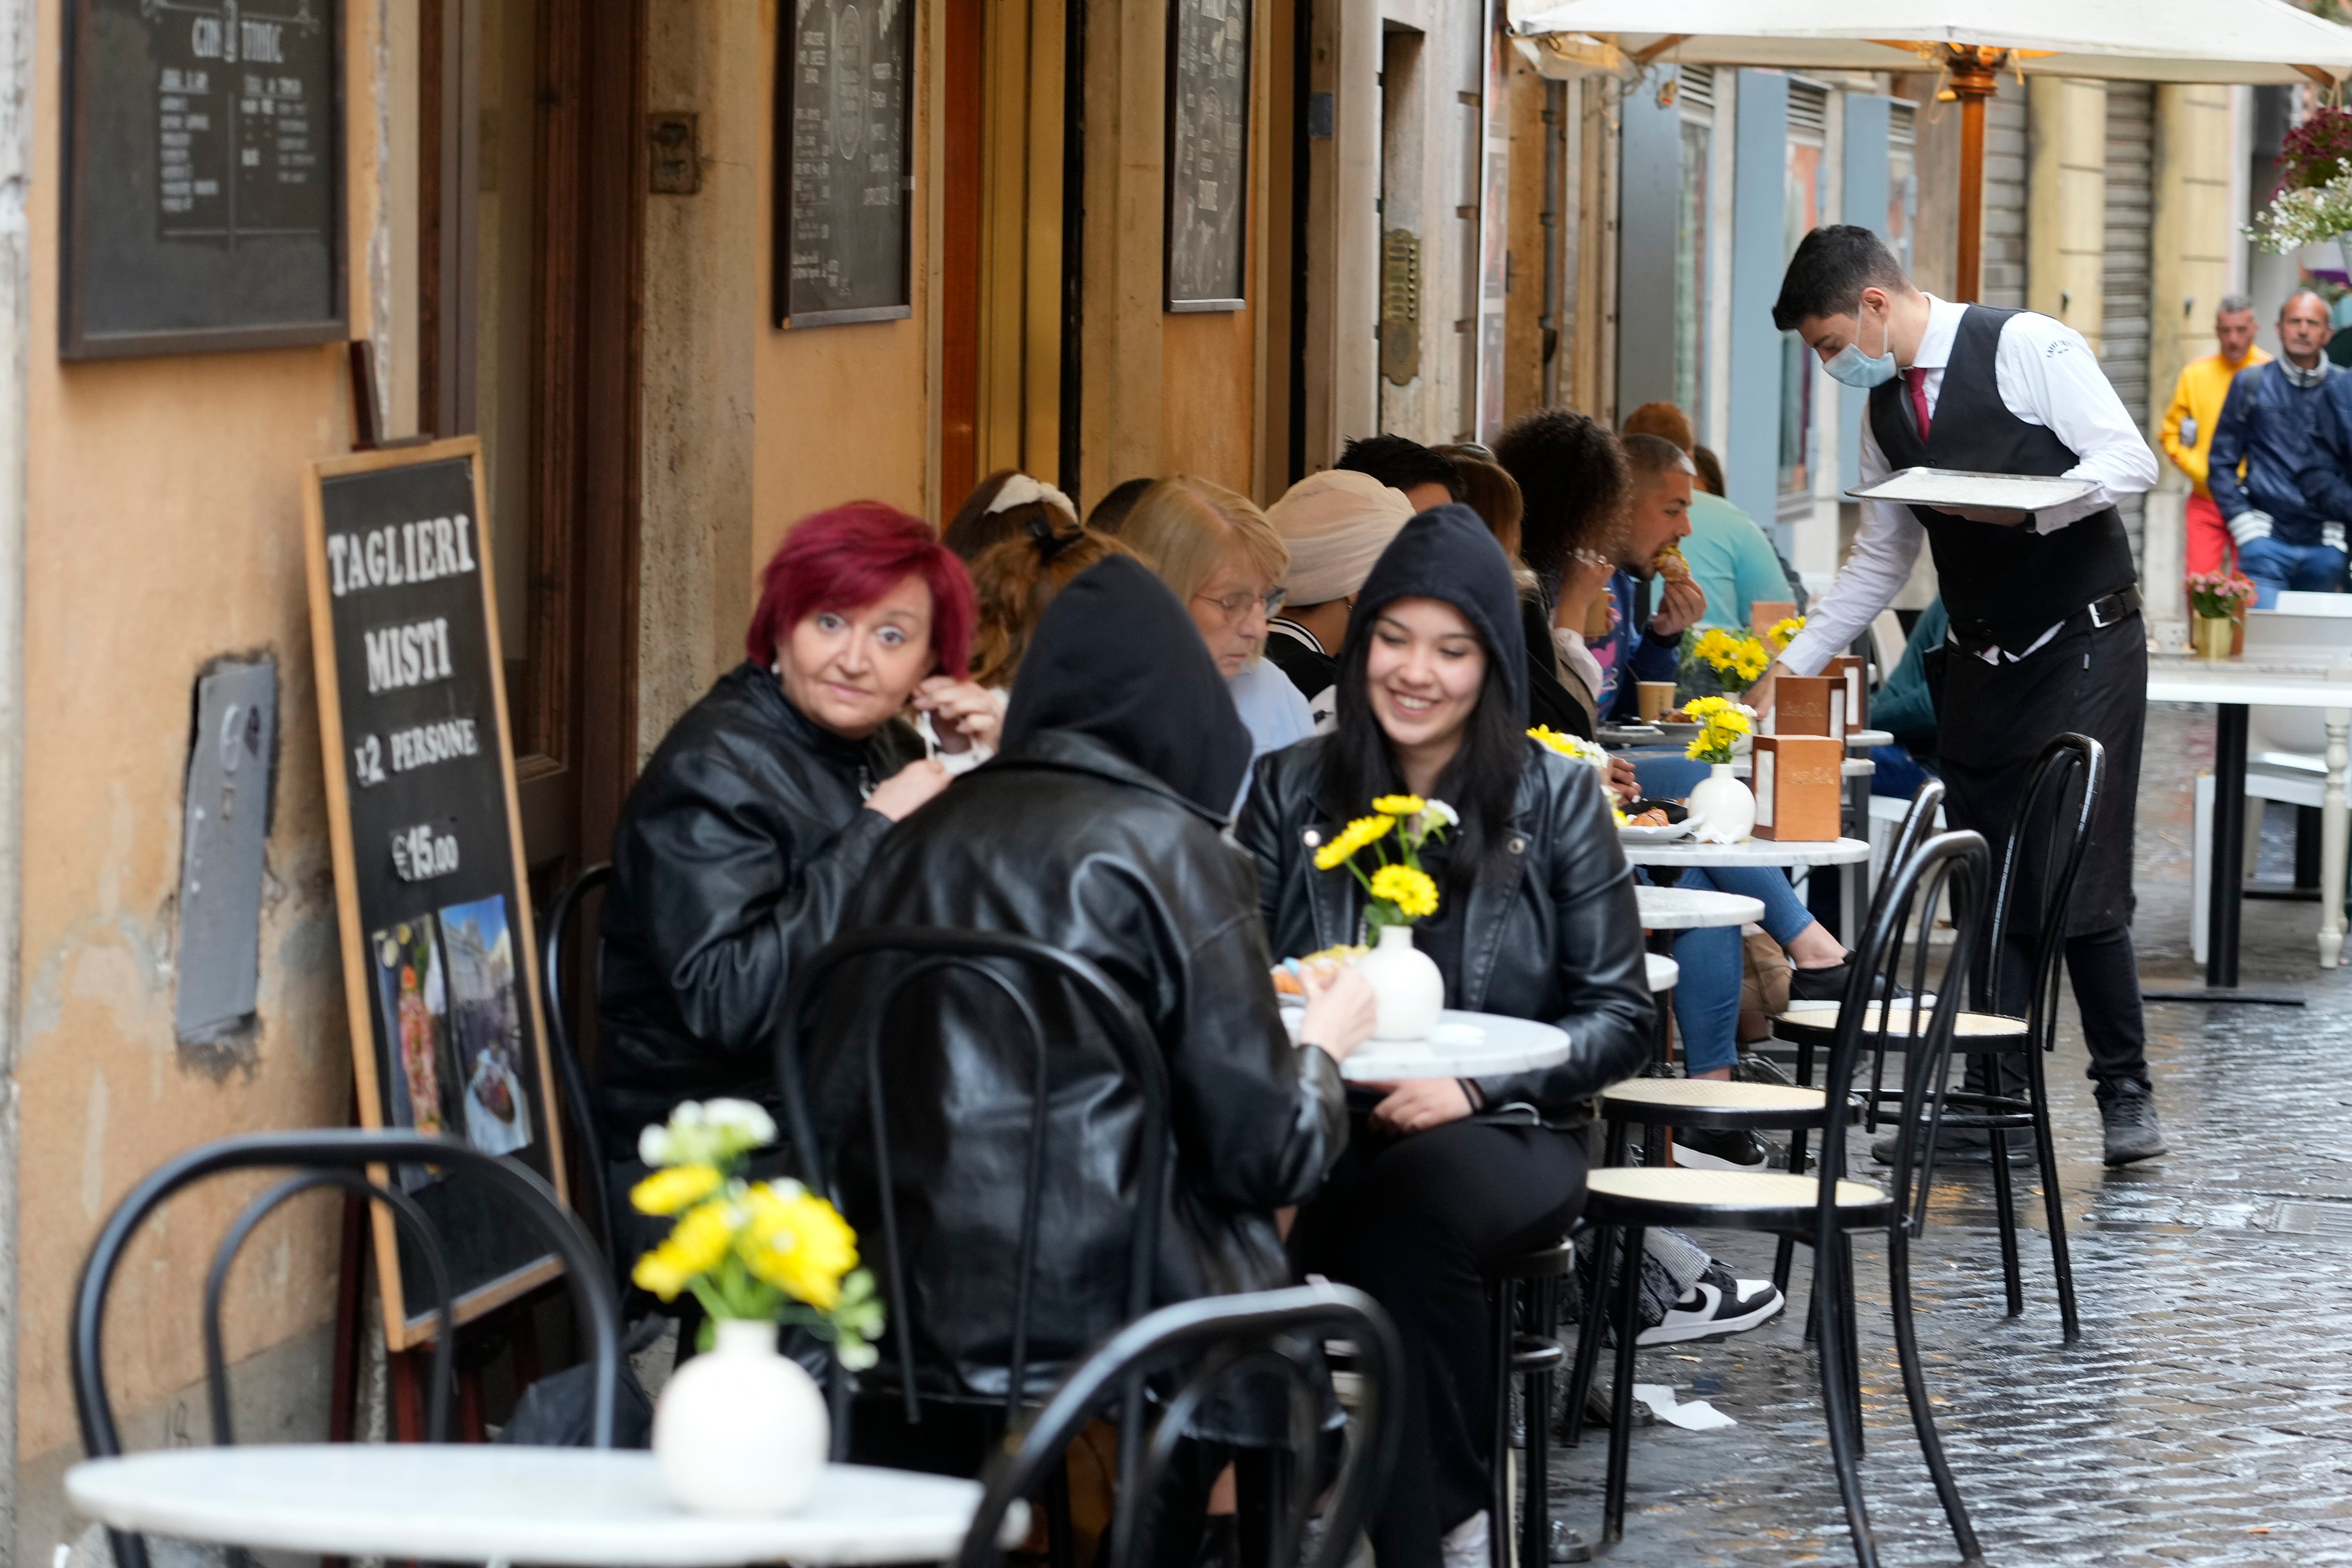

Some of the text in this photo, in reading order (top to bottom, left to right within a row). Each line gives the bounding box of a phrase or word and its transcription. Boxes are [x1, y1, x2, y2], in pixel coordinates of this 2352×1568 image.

[327, 514, 476, 597] TAGLIERI
[364, 617, 452, 693] MISTI
[389, 719, 479, 772] PERSONE
